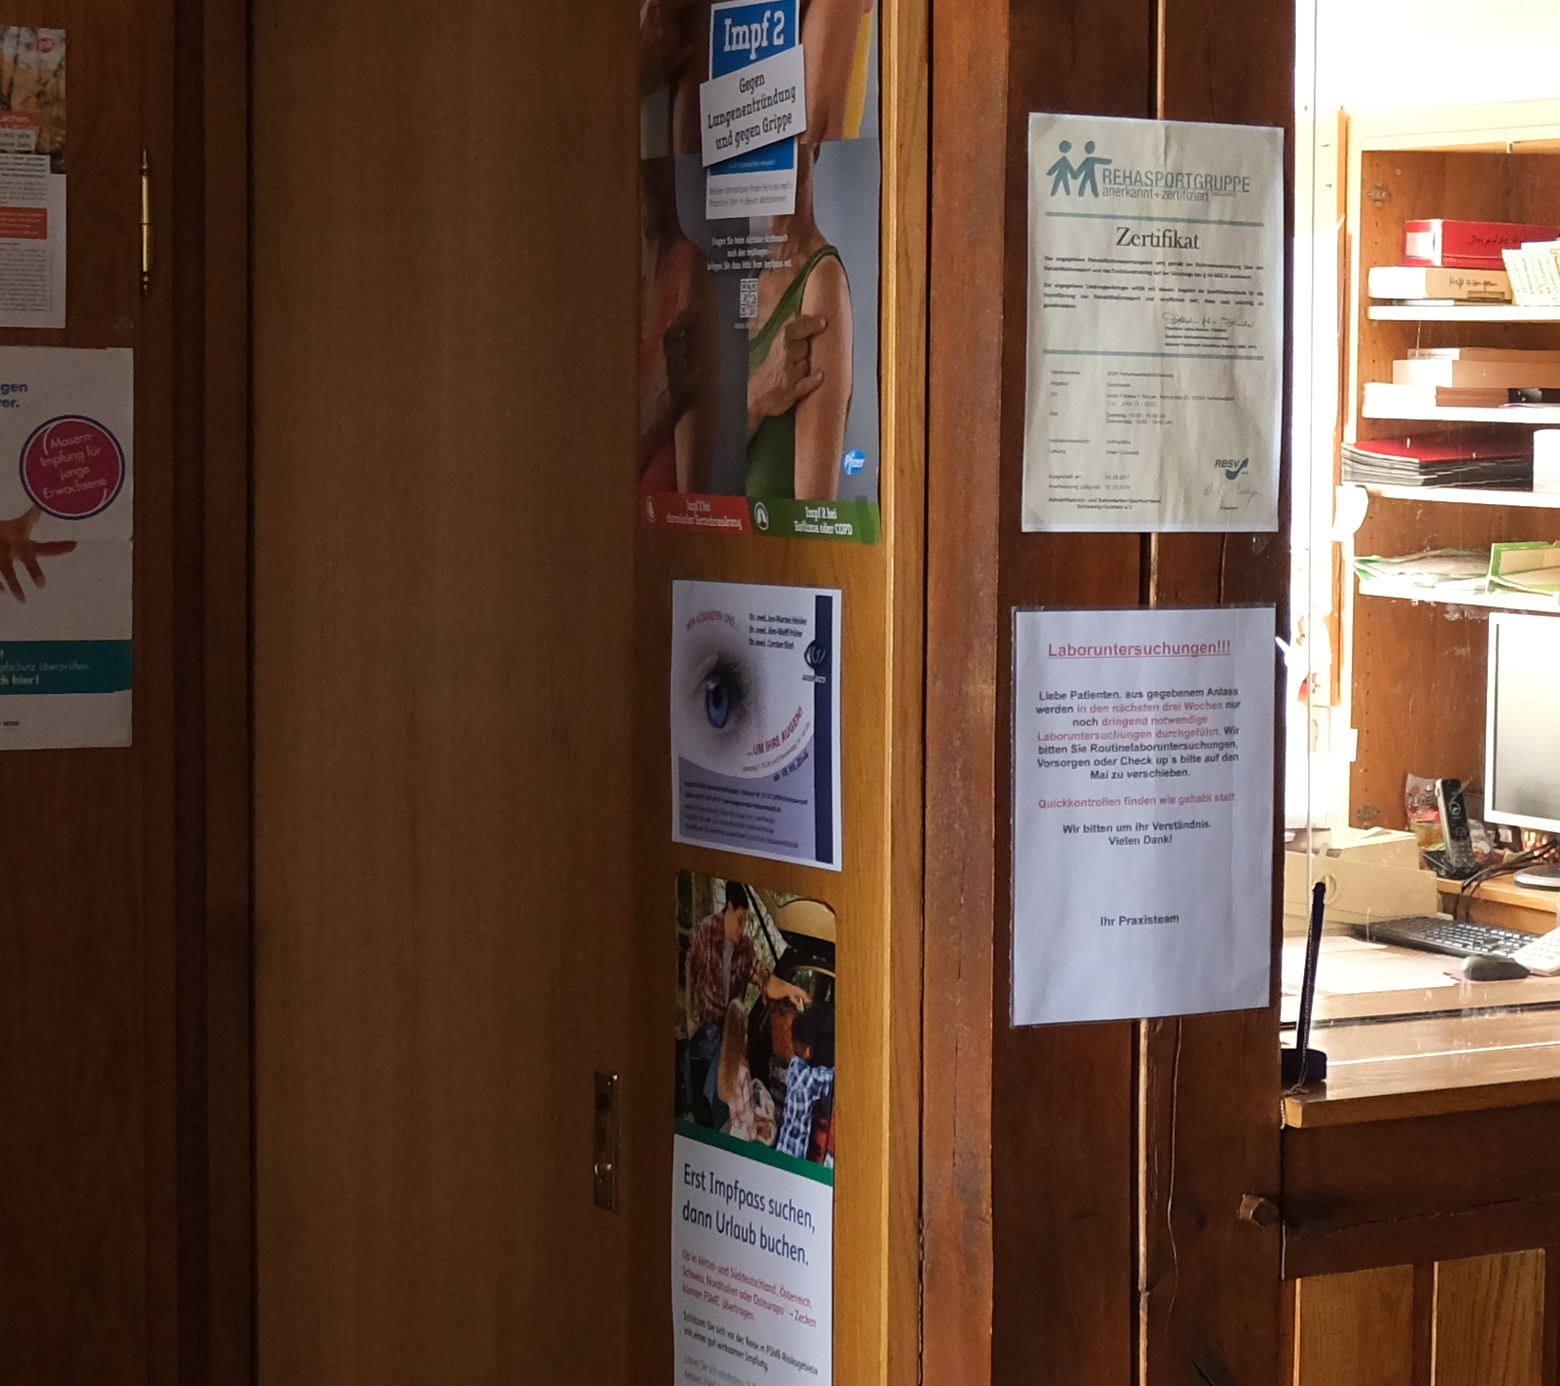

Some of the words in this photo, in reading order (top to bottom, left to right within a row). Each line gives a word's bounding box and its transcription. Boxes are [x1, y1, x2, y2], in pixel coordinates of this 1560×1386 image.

[724, 10, 771, 60] Impf
[772, 10, 785, 46] 2
[739, 73, 765, 94] Gegen
[715, 130, 732, 150] und
[734, 124, 761, 148] gegen
[762, 111, 792, 134] Grippe
[1102, 168, 1250, 194] REHASPORTGRUPPE
[1116, 226, 1201, 250] Zertifikat
[60, 465, 90, 482] junge
[42, 478, 107, 500] Erwachsene
[834, 522, 853, 536] COPD
[1048, 640, 1231, 659] Laboruntersuchungen!!!
[12, 674, 40, 686] hier!
[1038, 692, 1067, 702] Liebe
[1125, 691, 1143, 700] aus
[1147, 689, 1204, 701] gegebenem
[1207, 687, 1239, 698] Anlass
[1035, 705, 1074, 715] werden
[1077, 704, 1087, 715] in
[1090, 703, 1109, 714] den
[1112, 702, 1160, 713] nächsten
[1163, 700, 1182, 712] drei
[1184, 700, 1222, 712] Wochen
[1224, 701, 1242, 710] nur
[1072, 716, 1099, 727] noch
[1101, 714, 1148, 729] dringend
[1151, 714, 1208, 727] notwendige
[1037, 730, 1152, 743] Laboruntersuchungen
[1223, 725, 1239, 736] Wir
[1038, 743, 1068, 755] bitten
[1071, 743, 1087, 754] Sie
[1037, 756, 1090, 769] Vorsorgen
[1093, 755, 1117, 767] oder
[1120, 754, 1152, 766] Check
[1180, 752, 1202, 764] bitte
[1204, 752, 1220, 763] auf
[1222, 750, 1240, 762] den
[1090, 770, 1108, 780] Mai
[1111, 771, 1124, 780] zu
[1127, 768, 1191, 780] verschieben.
[1038, 797, 1120, 809] Quickkontrollen
[1124, 795, 1156, 806] finden
[1159, 794, 1176, 805] wie
[1178, 793, 1212, 806] gehabt
[1062, 824, 1080, 835] Wir
[1083, 822, 1113, 834] bitten
[1115, 823, 1132, 832] um
[1108, 835, 1140, 846] Vielen
[1143, 834, 1173, 845] Dank!
[1100, 916, 1116, 927] Ihr
[1119, 914, 1181, 926] Praxisteam
[683, 1163, 705, 1192] Erst
[709, 1171, 765, 1210] Impfpass
[768, 1198, 815, 1235] suchen,
[682, 1199, 712, 1230] dann
[715, 1210, 756, 1245] Urlaub
[760, 1225, 809, 1266] buchen.
[794, 1309, 817, 1328] Zecken
